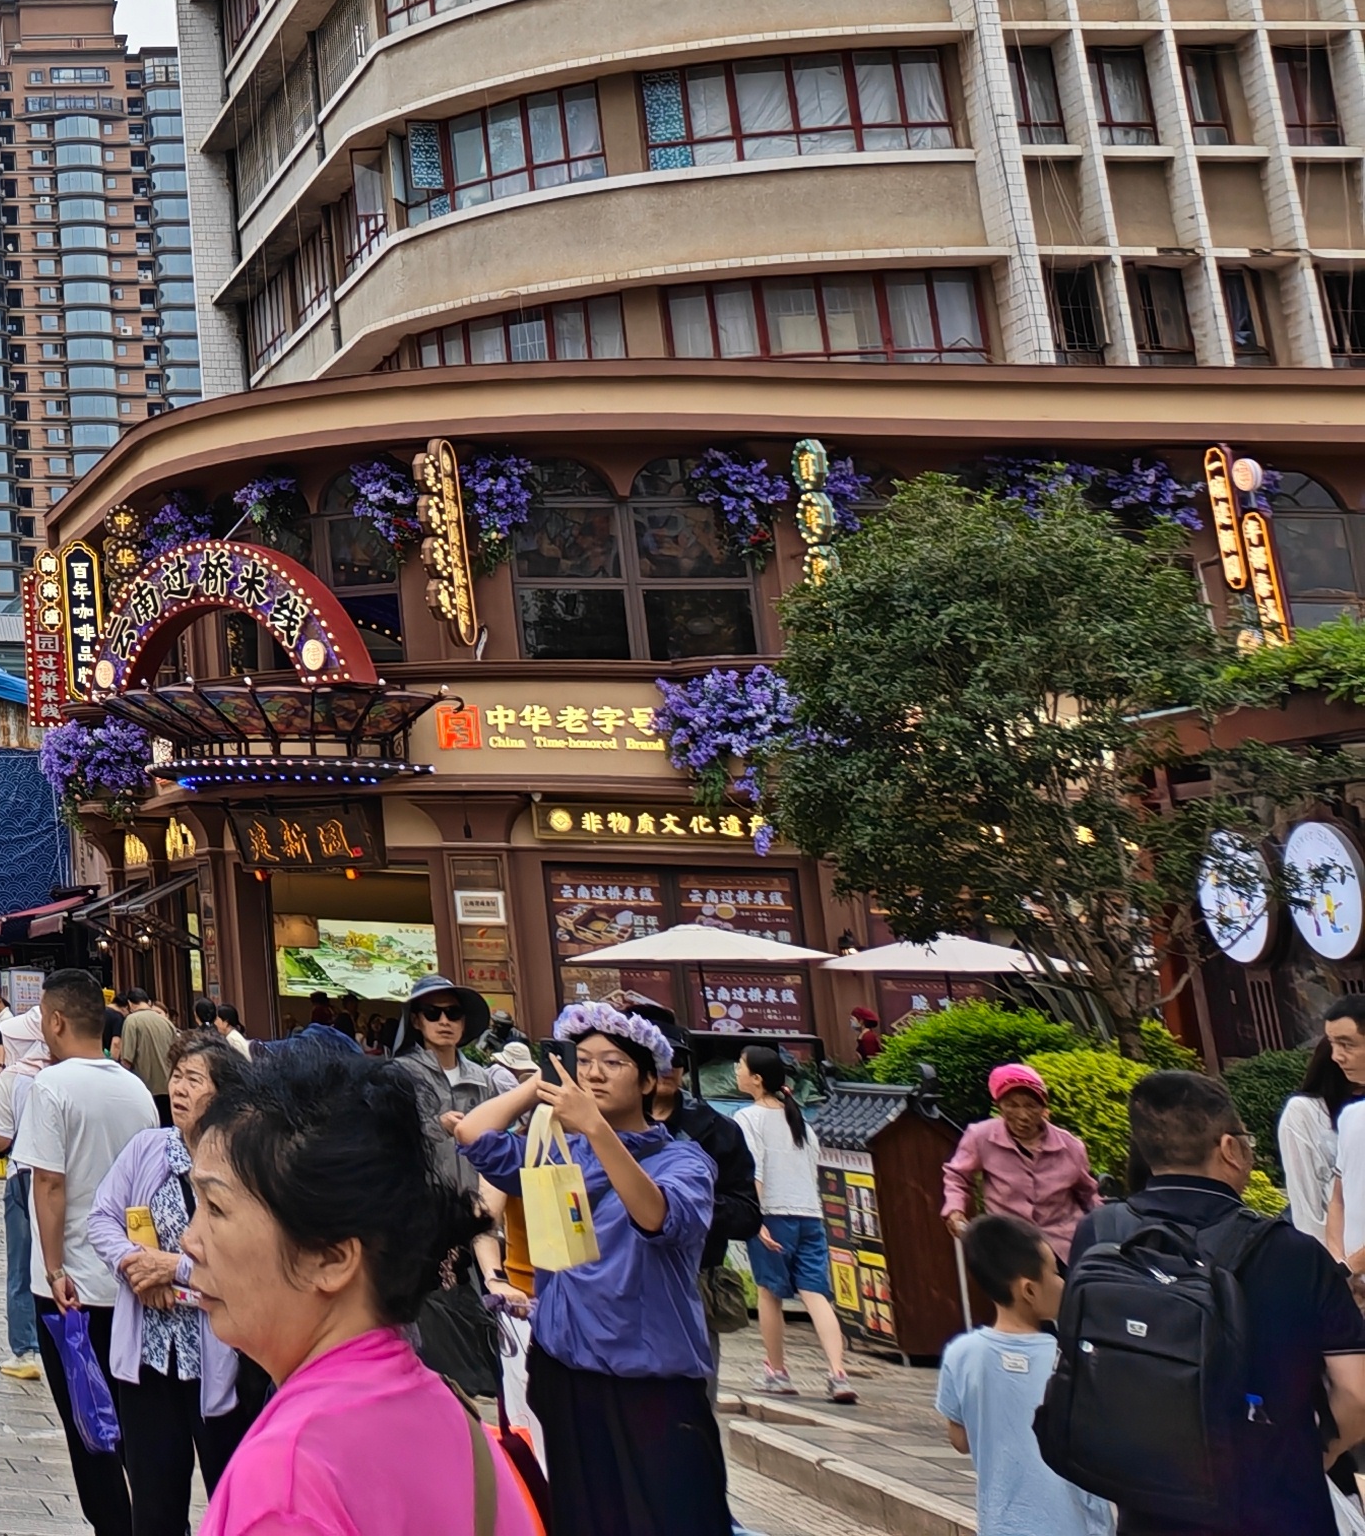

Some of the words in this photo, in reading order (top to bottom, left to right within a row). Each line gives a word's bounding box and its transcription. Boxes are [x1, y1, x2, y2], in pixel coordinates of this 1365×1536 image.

[40, 556, 61, 625] 南来盛
[106, 548, 307, 660] 云南过桥米线
[485, 703, 657, 736] 中华老字号
[488, 736, 527, 749] China
[533, 735, 619, 750] Time-honored
[625, 737, 666, 752] Brand
[581, 811, 767, 838] 非物质文化遗产
[560, 884, 656, 902] 云南过桥米线
[688, 889, 786, 906] 云南过桥米线
[700, 985, 798, 1005] 云南过桥米线
